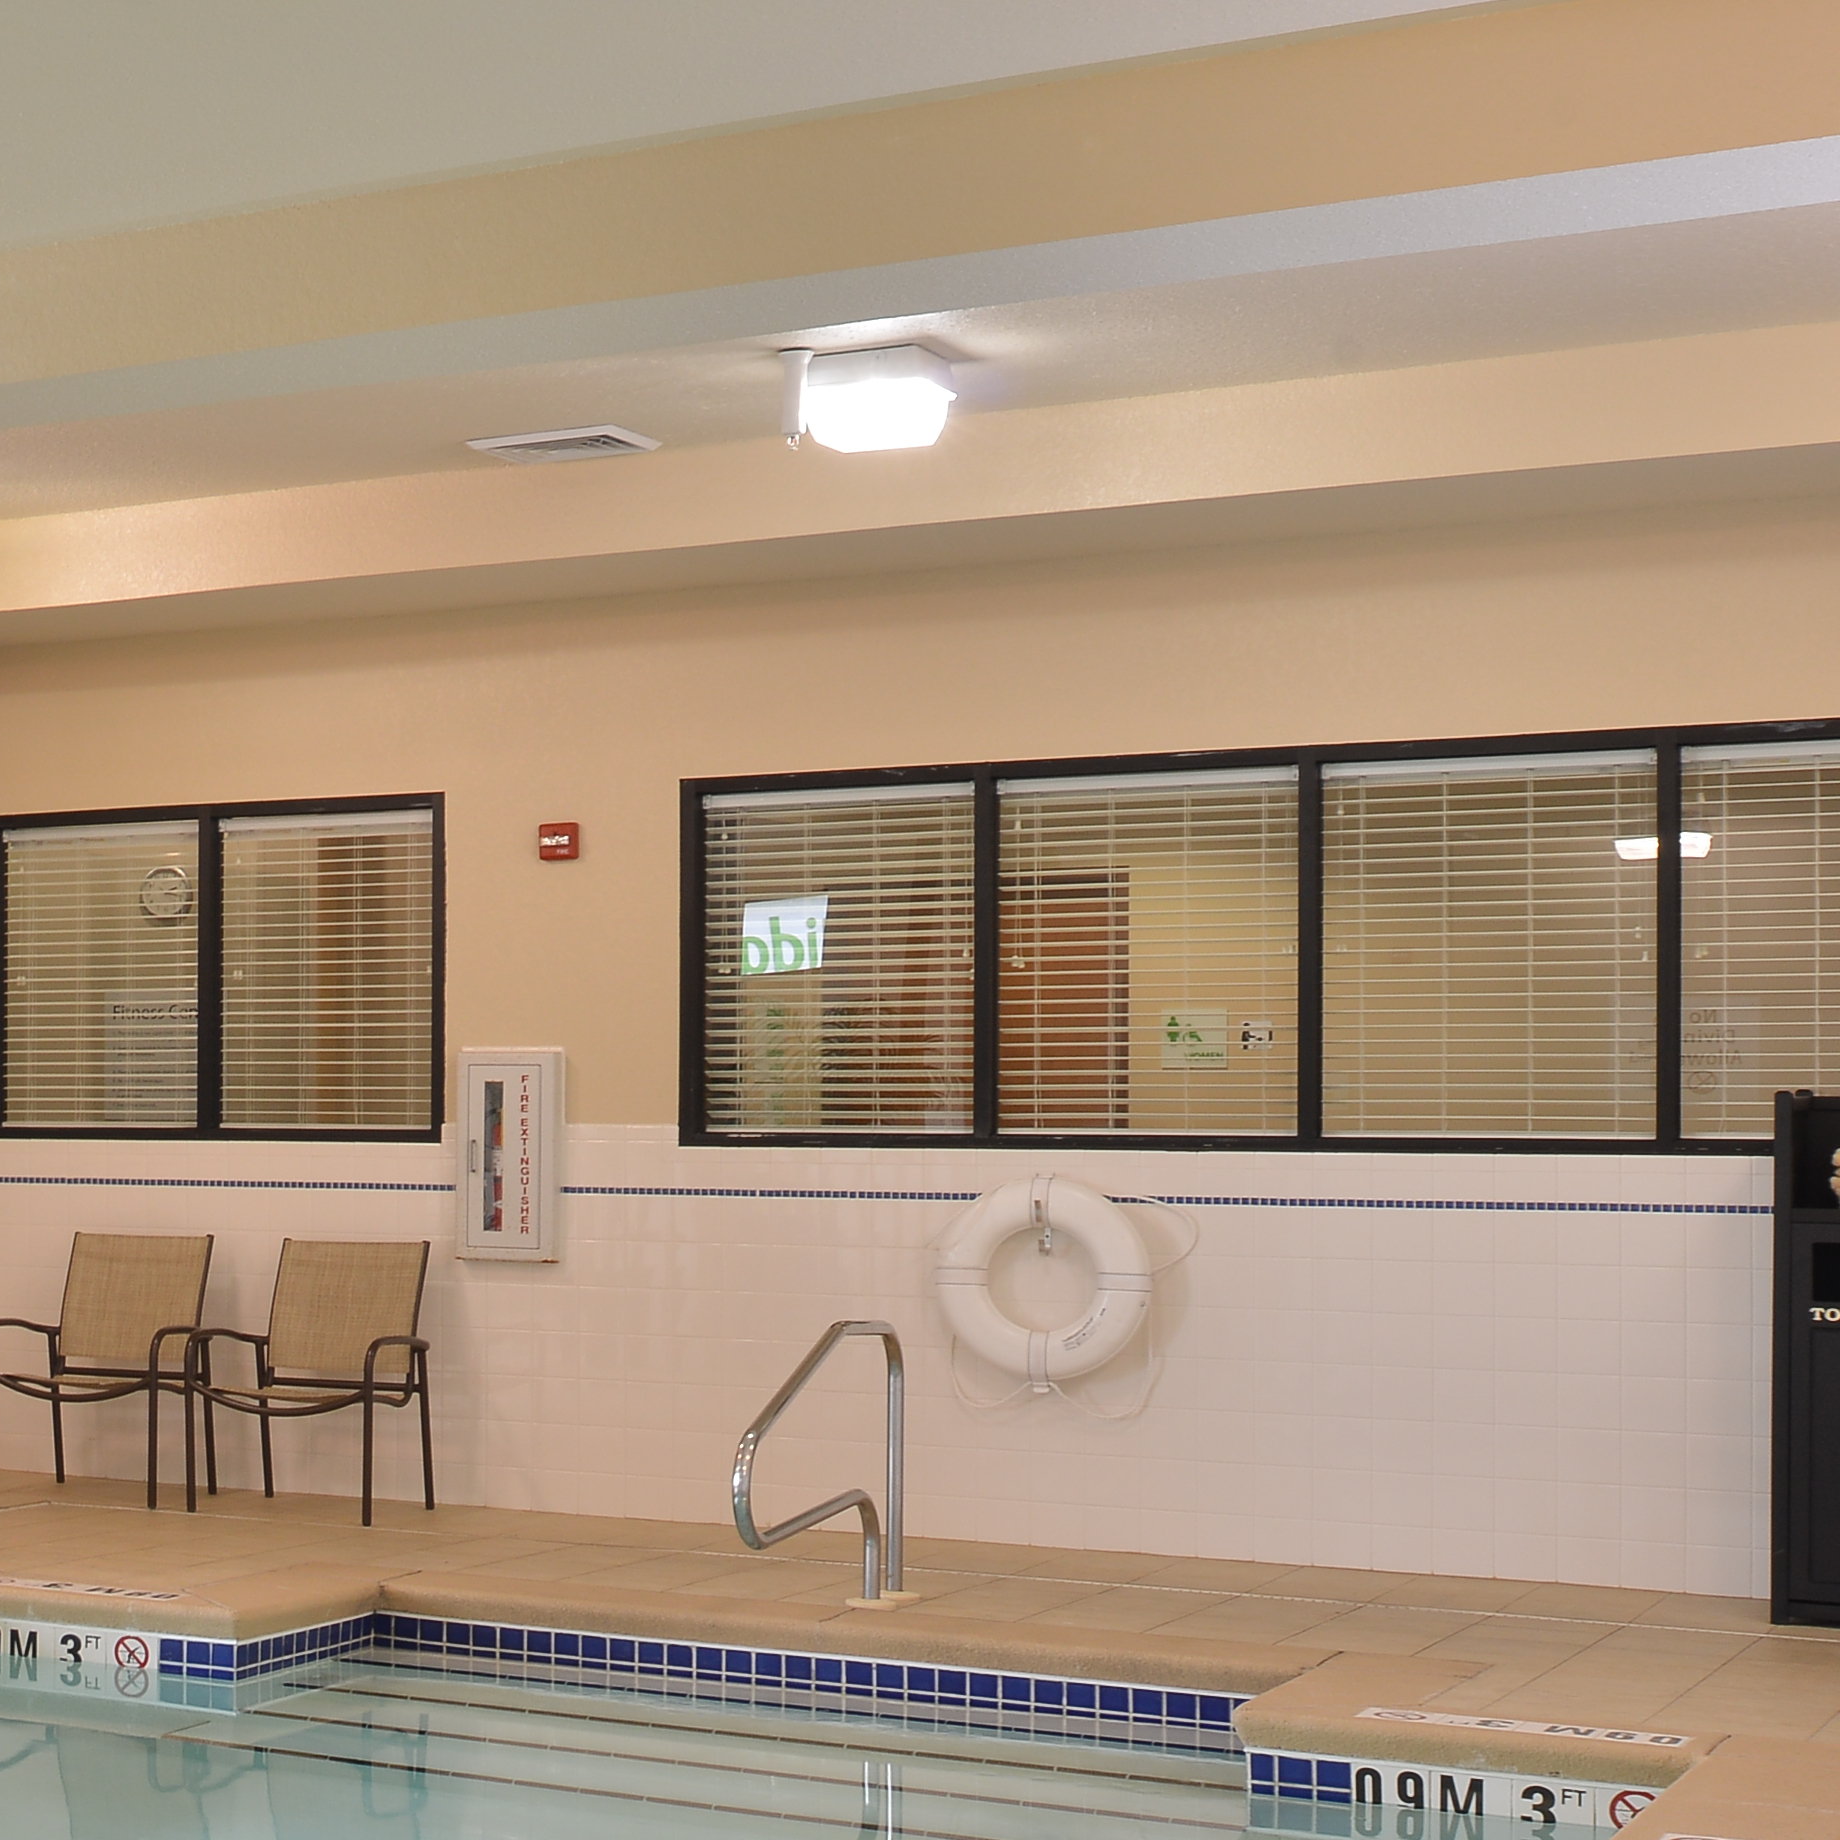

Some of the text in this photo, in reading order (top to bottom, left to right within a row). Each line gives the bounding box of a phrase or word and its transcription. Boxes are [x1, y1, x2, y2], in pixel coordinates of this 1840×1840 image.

[113, 1004, 165, 1020] Fitness
[520, 1074, 529, 1234] FIRE EXTINGUISHER
[85, 1635, 101, 1651] FT
[1521, 1784, 1557, 1824] 3
[1561, 1788, 1588, 1808] FT
